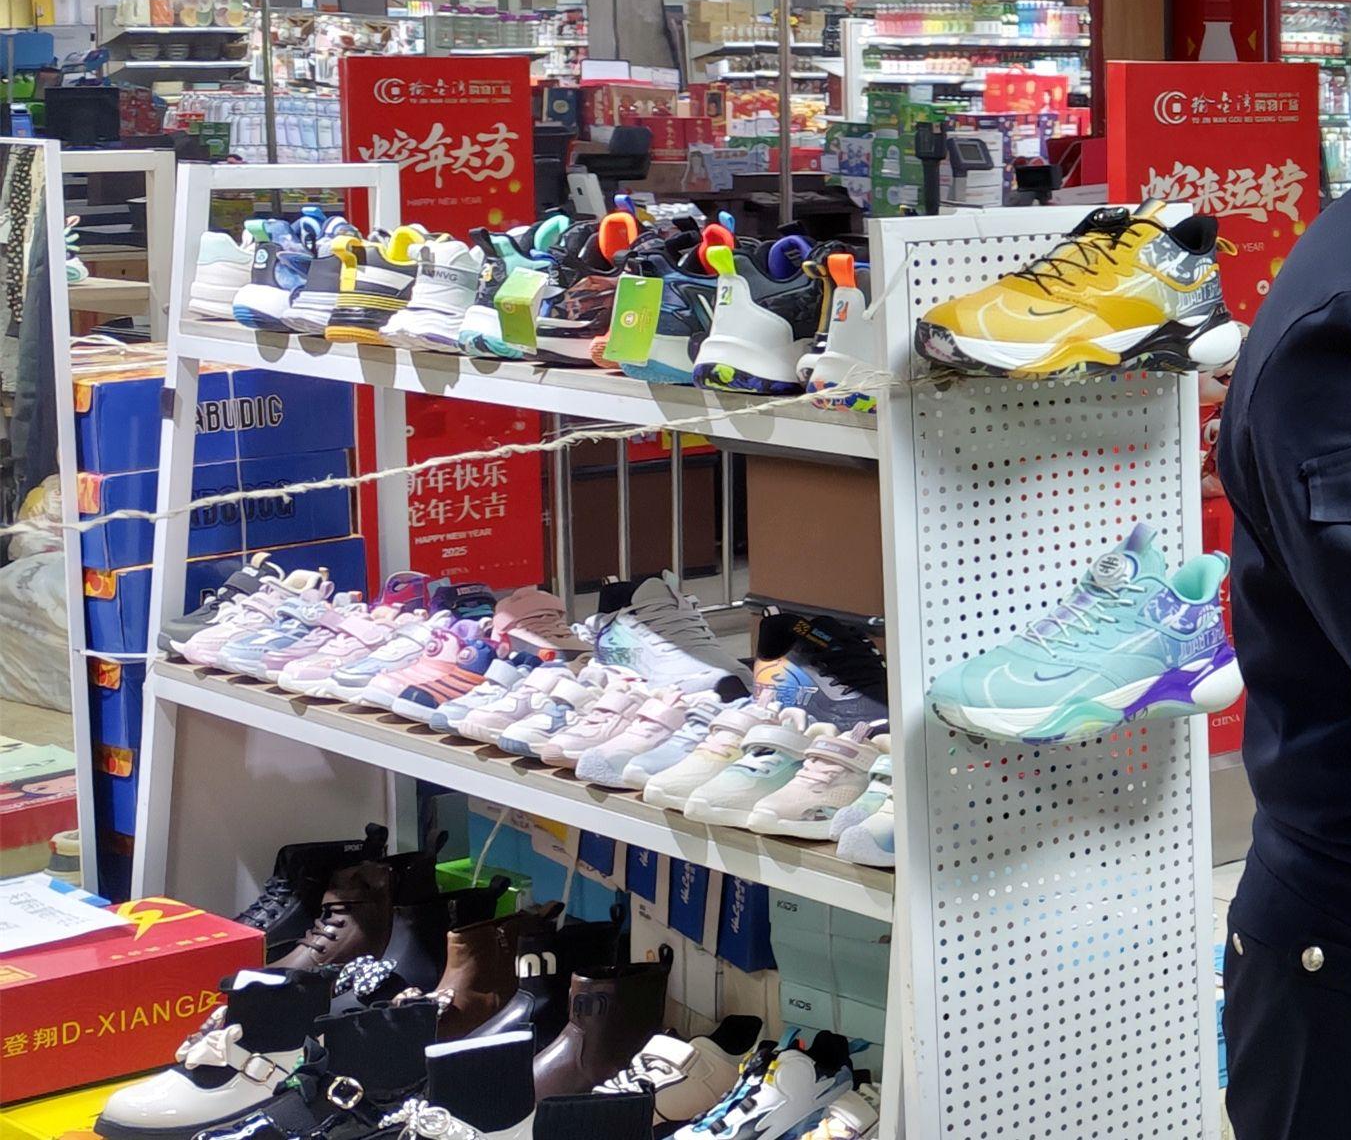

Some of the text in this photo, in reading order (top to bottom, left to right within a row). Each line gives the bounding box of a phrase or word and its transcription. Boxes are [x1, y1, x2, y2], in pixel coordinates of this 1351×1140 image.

[1242, 241, 1265, 253] YEAR
[442, 545, 467, 558] 2025
[1211, 714, 1241, 728] CHINA
[343, 843, 364, 853] SPORT
[776, 899, 798, 913] KIDS
[788, 997, 812, 1012] KIDS
[3, 1026, 58, 1058] 登翔
